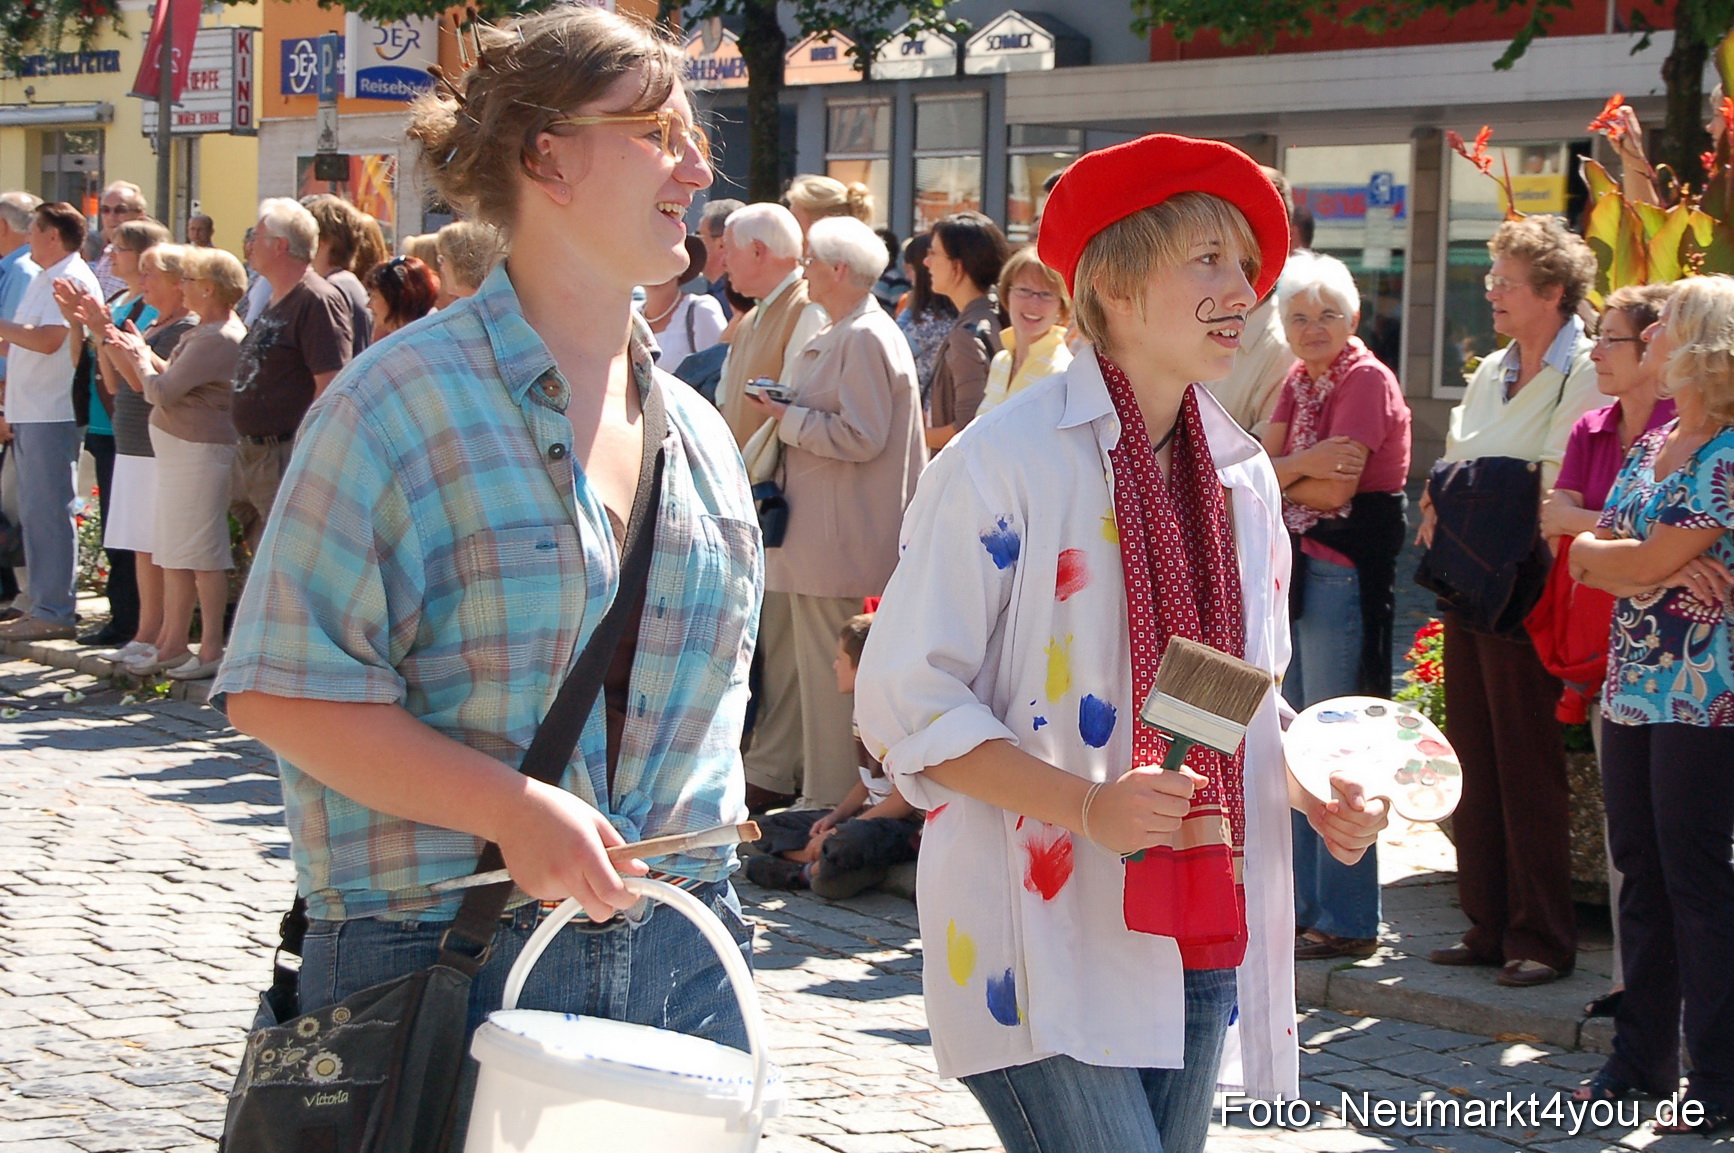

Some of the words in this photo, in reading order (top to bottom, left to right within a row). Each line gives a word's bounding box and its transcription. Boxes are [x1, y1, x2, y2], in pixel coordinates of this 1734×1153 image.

[373, 26, 421, 50] DER
[238, 33, 250, 126] KINO
[304, 1089, 350, 1108] Victoria
